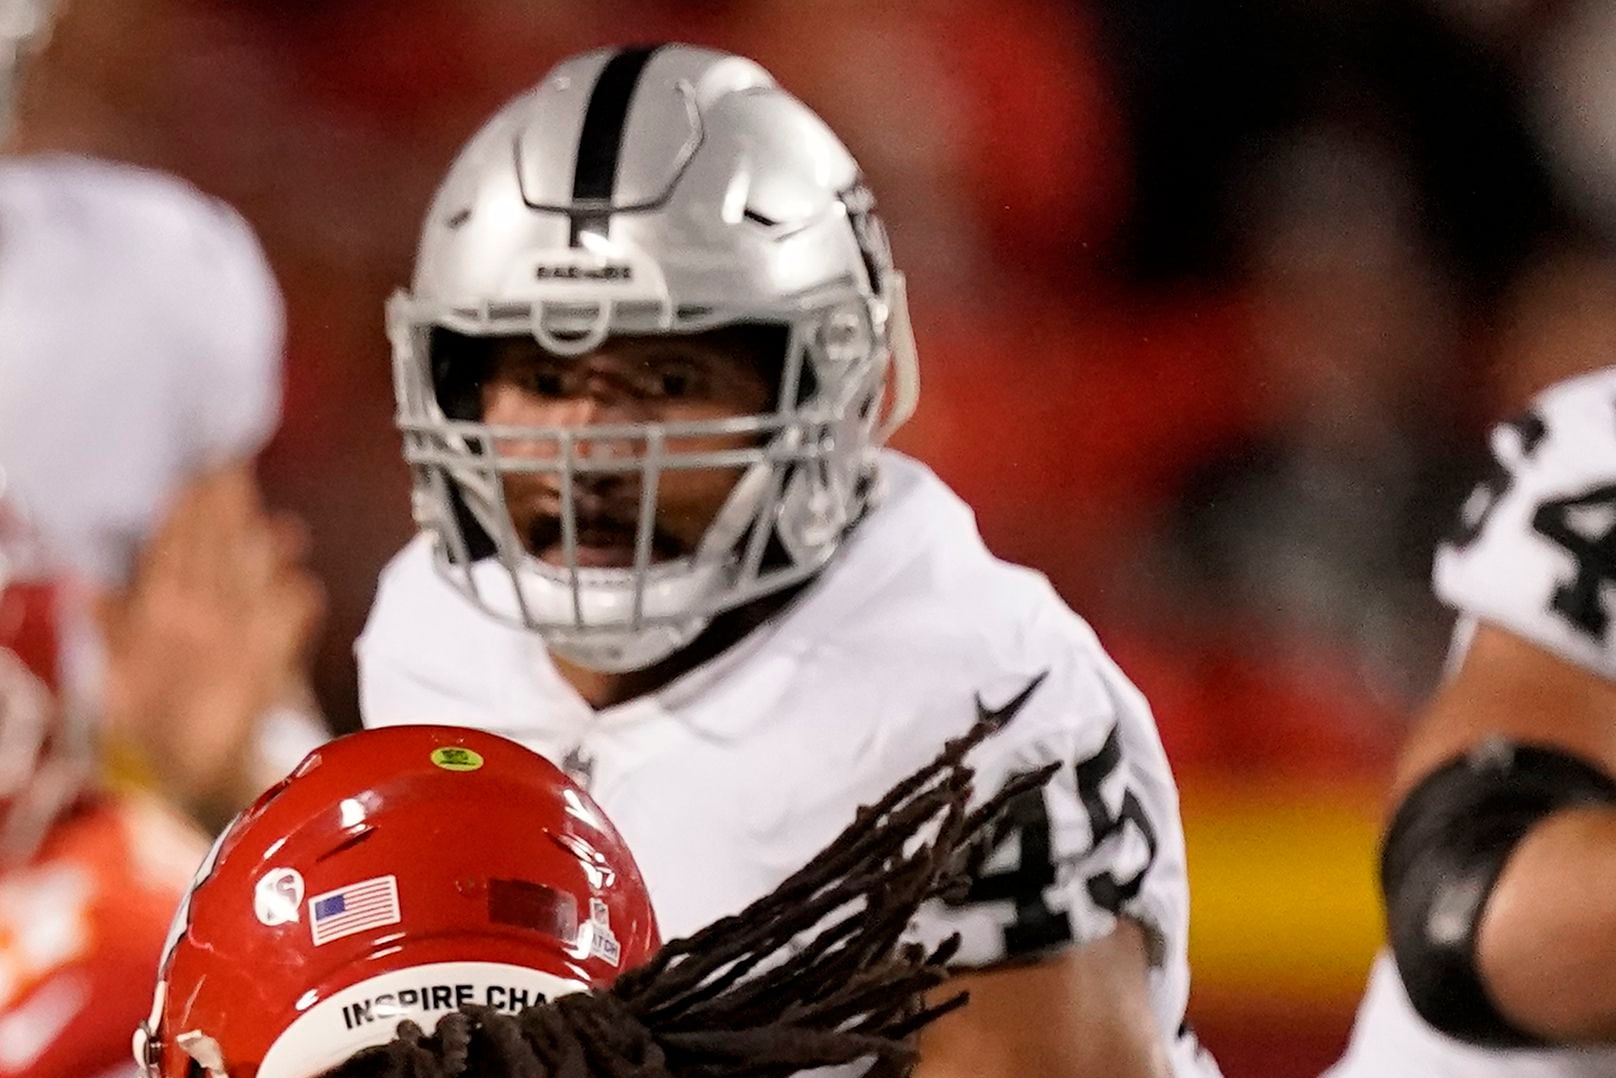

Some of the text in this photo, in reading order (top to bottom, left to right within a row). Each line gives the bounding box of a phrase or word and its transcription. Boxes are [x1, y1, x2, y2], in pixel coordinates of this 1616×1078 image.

[961, 722, 1158, 959] 45
[342, 984, 549, 1030] INSPIRE CHA
